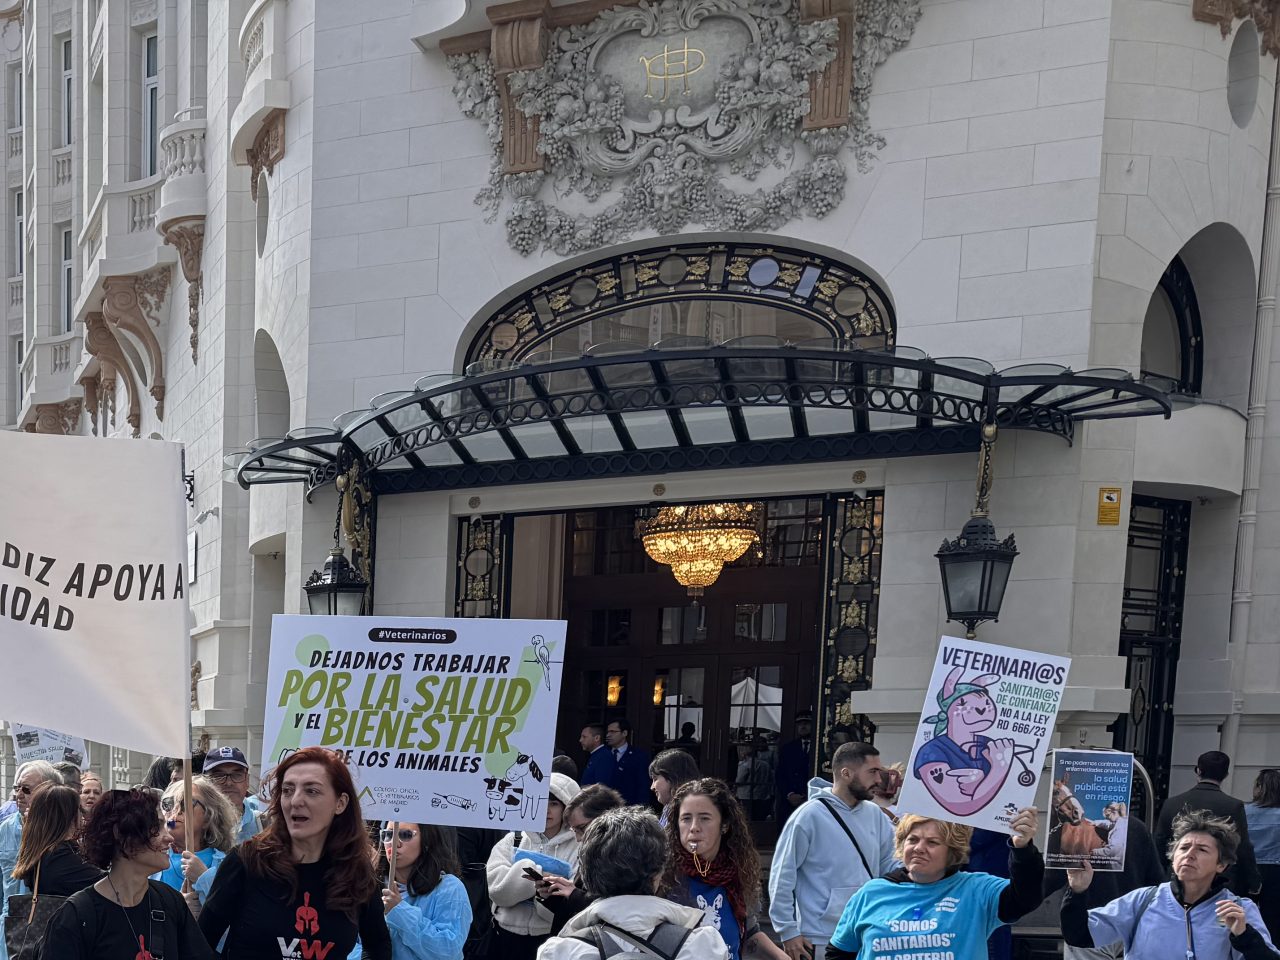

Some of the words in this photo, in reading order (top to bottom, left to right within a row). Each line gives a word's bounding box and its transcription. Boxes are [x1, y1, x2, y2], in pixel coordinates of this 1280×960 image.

[64, 562, 165, 602] APOYA
[173, 562, 184, 600] A
[378, 630, 447, 641] #Veterinarios
[310, 650, 405, 671] DEJADNOS
[412, 654, 511, 674] TRABAJAR
[942, 646, 1065, 685] VETERINARI@S
[278, 670, 352, 709] POR
[359, 674, 402, 711] LA
[411, 676, 532, 717] SALUD
[999, 682, 1060, 702] SANITARI@S
[996, 694, 1009, 705] DE
[1010, 696, 1056, 714] CONFIANZA
[1000, 708, 1011, 718] NO
[1014, 710, 1021, 719] A
[1021, 712, 1032, 722] LA
[1034, 714, 1050, 725] LEY
[294, 713, 304, 729] Y
[306, 714, 321, 729] EL
[320, 708, 518, 753] BIENESTAR
[997, 719, 1009, 730] RD
[1012, 722, 1046, 737] 666/23
[358, 750, 390, 768] LOS
[394, 752, 482, 773] ANIMALES
[1074, 782, 1106, 792] pública
[1108, 784, 1127, 792] está
